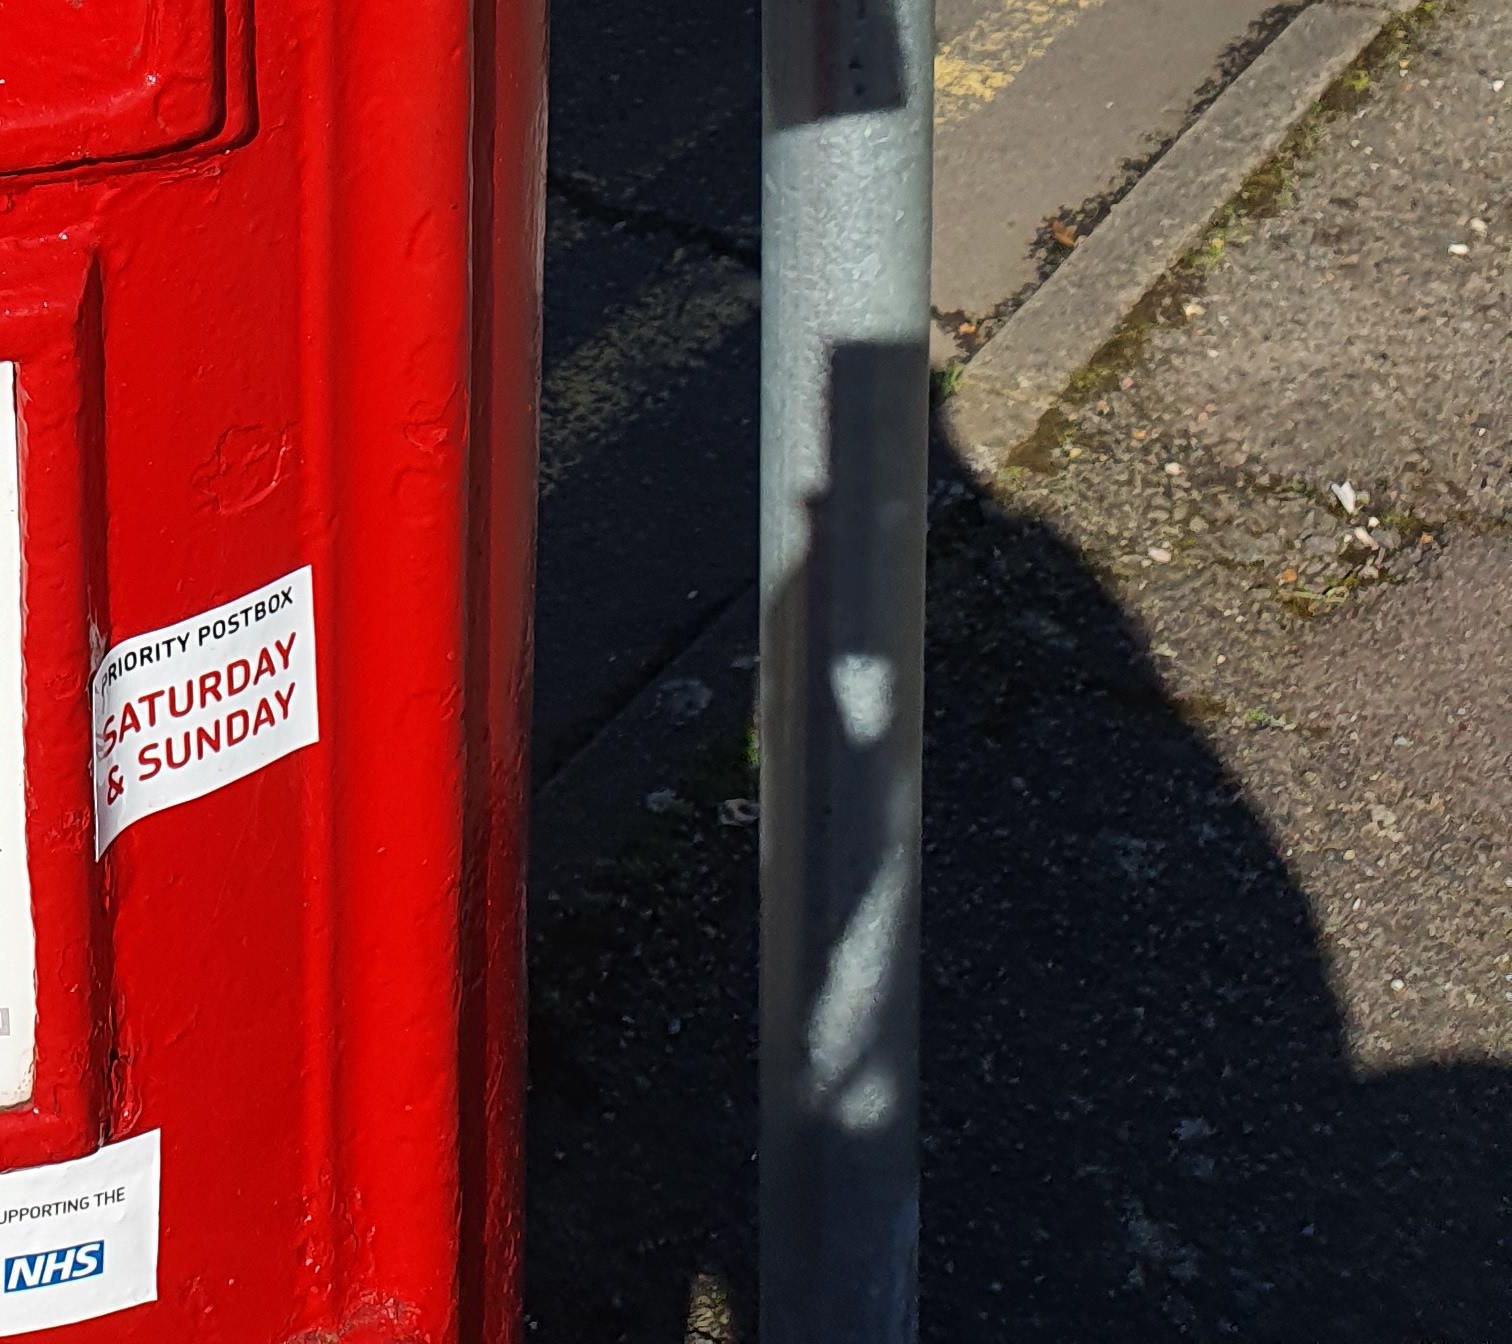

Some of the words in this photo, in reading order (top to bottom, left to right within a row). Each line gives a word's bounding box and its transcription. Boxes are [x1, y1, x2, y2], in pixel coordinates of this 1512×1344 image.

[101, 632, 190, 692] PRIORITY
[198, 586, 293, 647] POSTBOX
[102, 632, 296, 758] SATURDAY
[107, 765, 124, 806] &
[139, 682, 296, 781] SUNDAY
[93, 1187, 126, 1208] THE
[7, 1242, 101, 1290] NHS
